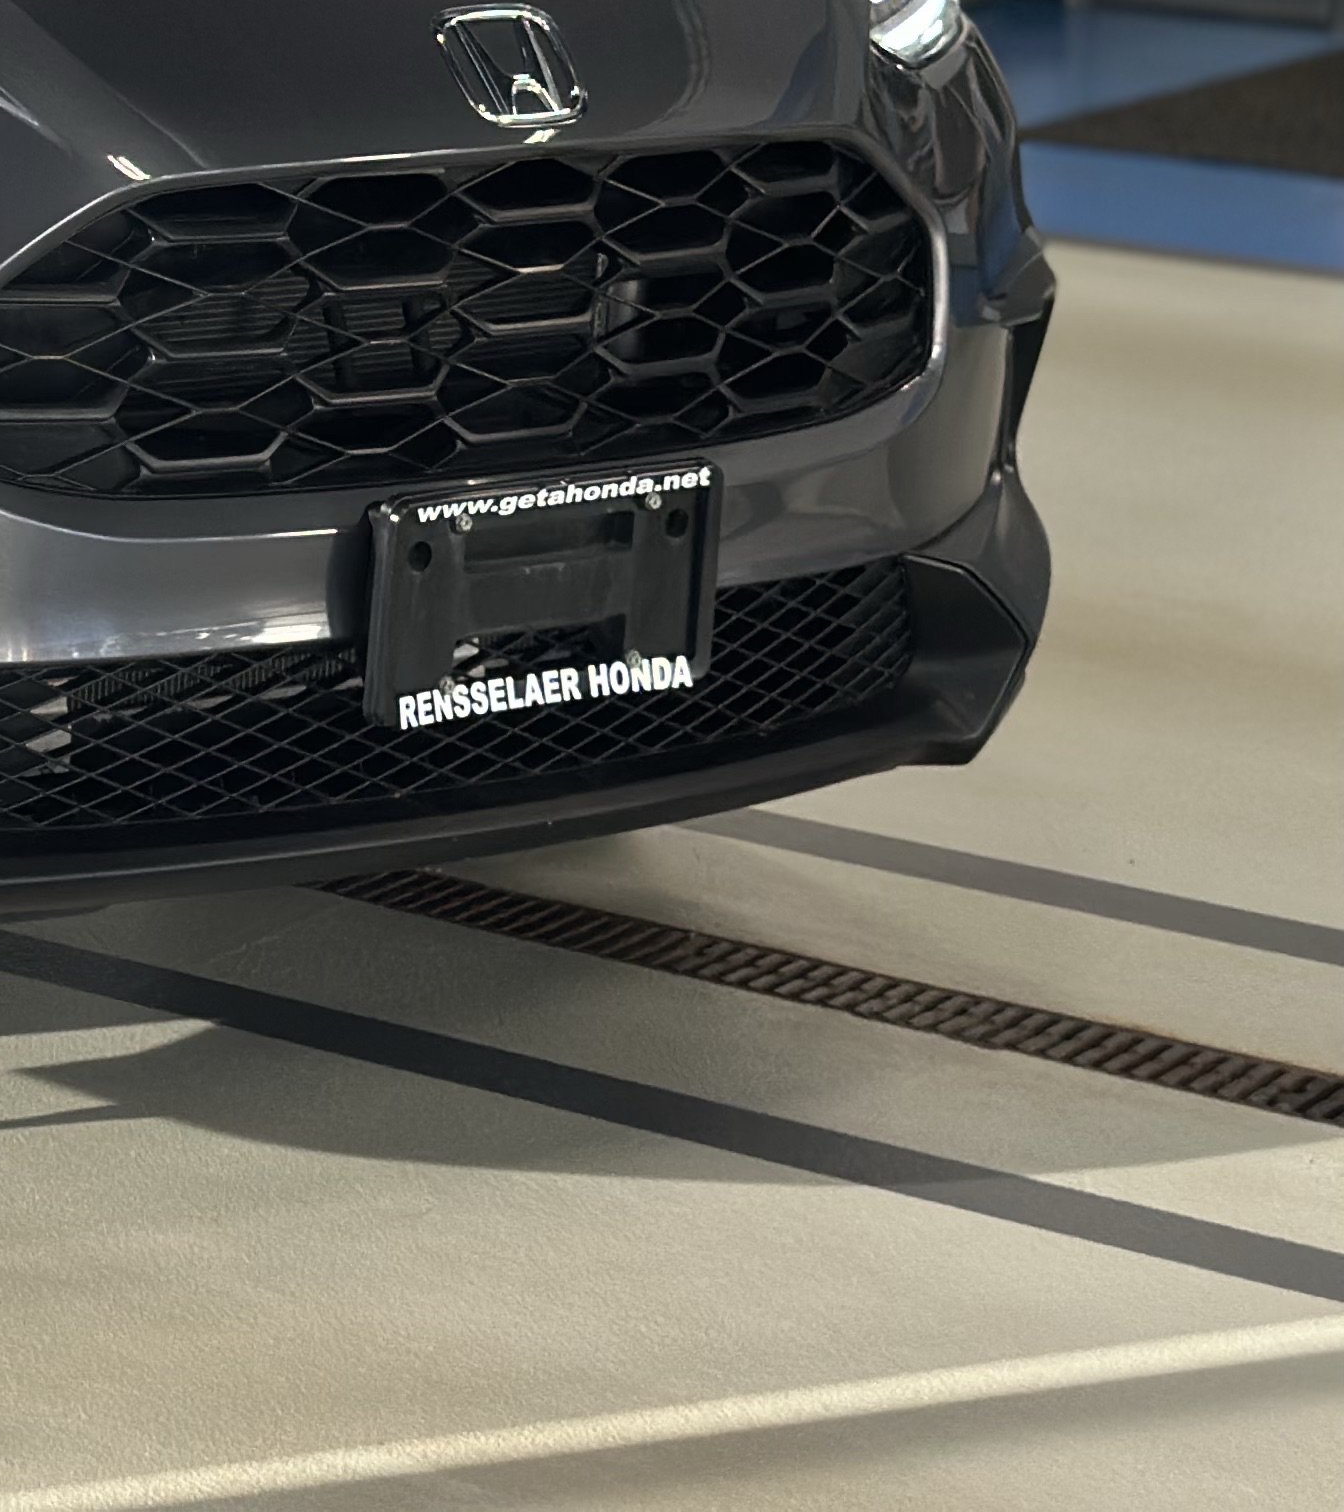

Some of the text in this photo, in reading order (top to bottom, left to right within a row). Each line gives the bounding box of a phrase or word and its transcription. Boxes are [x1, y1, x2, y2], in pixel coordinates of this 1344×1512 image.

[417, 467, 711, 523] www.getahonda.net
[399, 655, 693, 730] RENSSELAER HONDA
